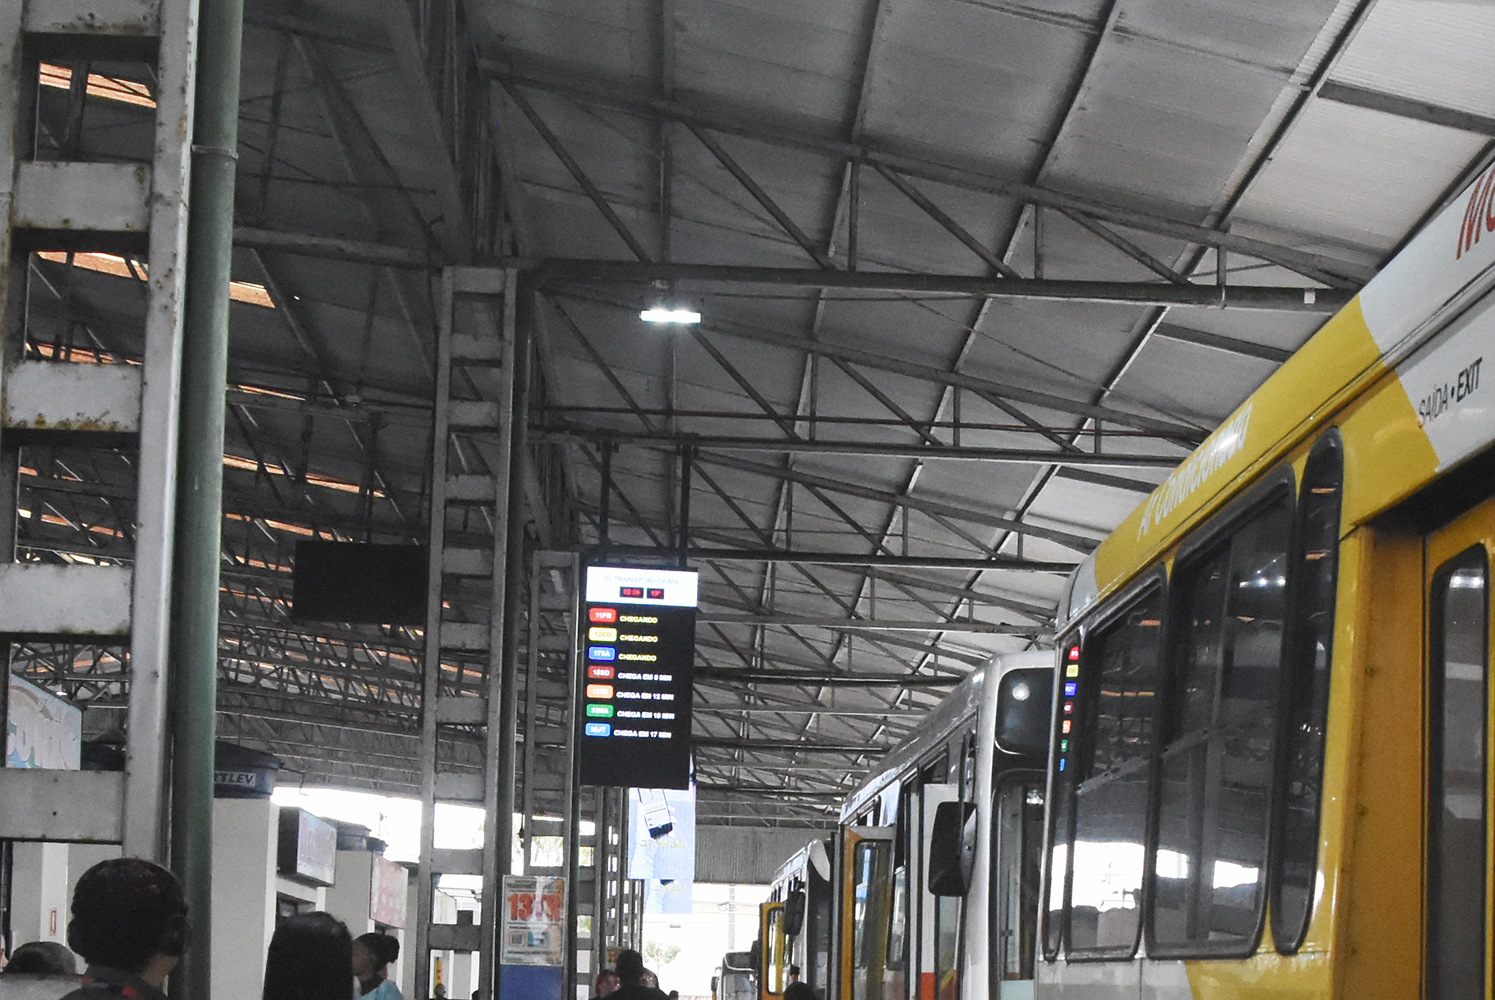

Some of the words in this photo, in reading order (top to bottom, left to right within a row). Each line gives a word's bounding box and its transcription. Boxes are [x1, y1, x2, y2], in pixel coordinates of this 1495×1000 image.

[1456, 356, 1483, 403] EXIT
[619, 615, 658, 624] CHEGANDO
[619, 634, 658, 643] CHEGANDO
[618, 653, 657, 662] CHEGANDO
